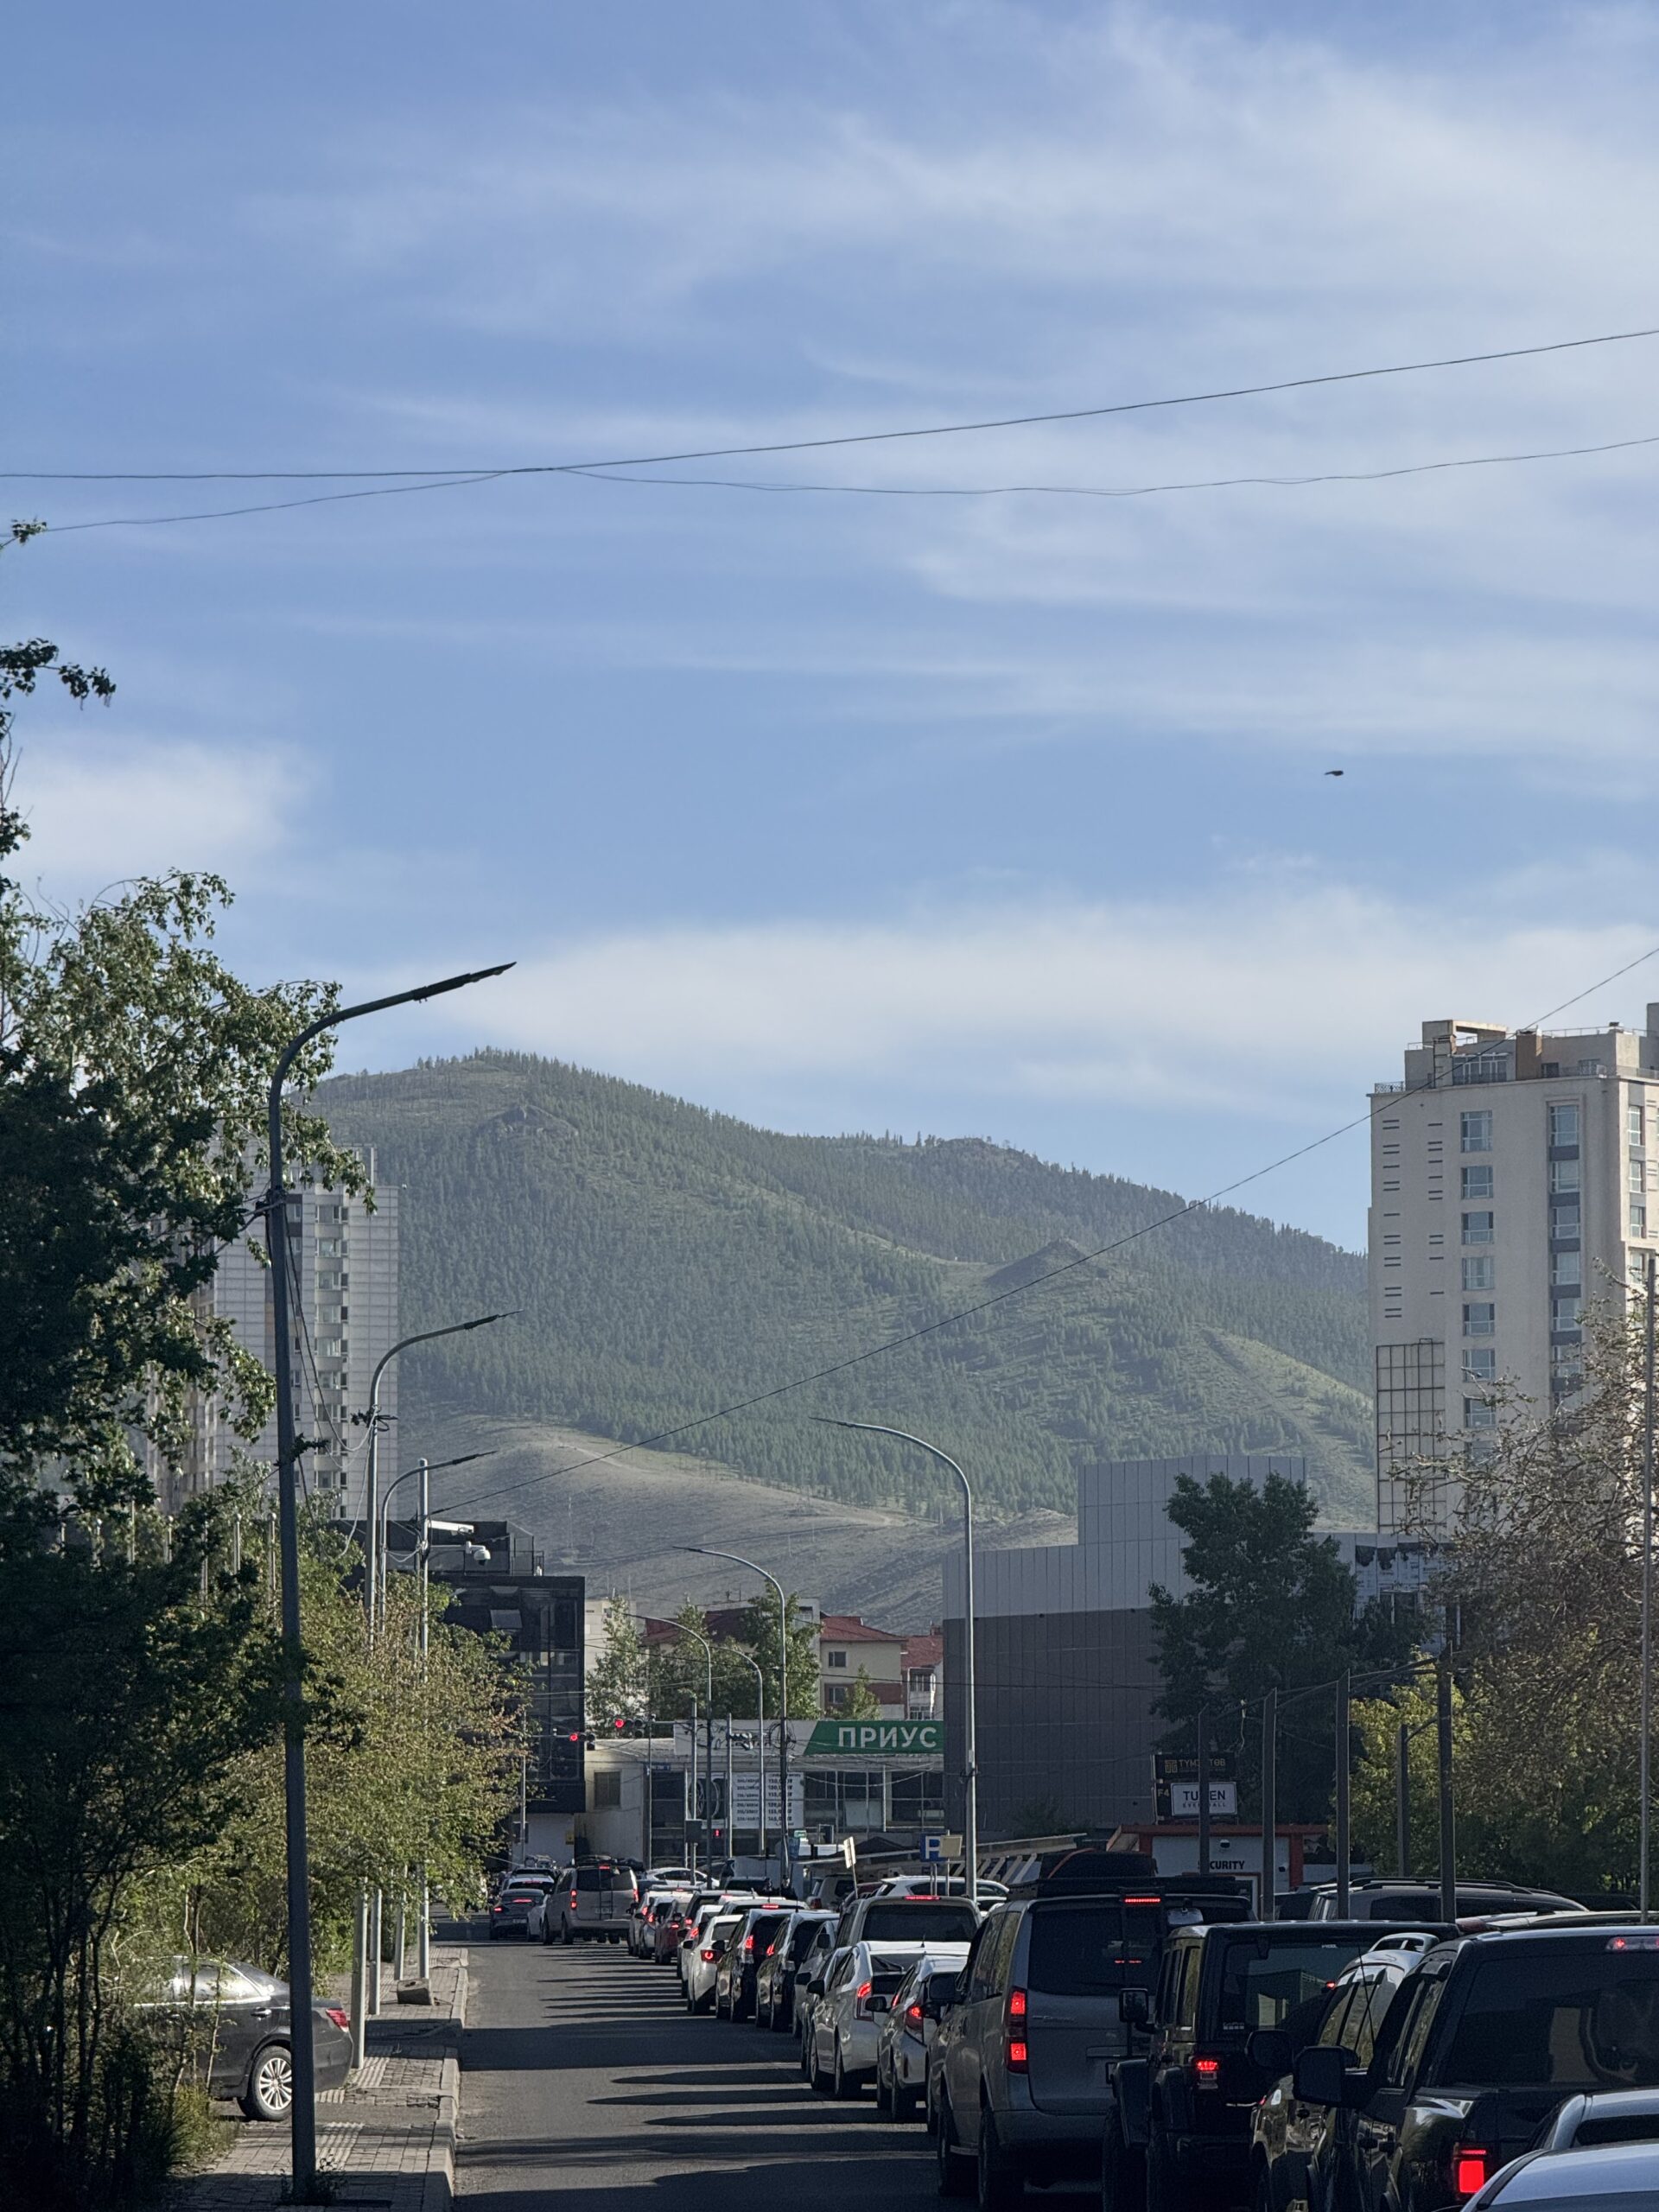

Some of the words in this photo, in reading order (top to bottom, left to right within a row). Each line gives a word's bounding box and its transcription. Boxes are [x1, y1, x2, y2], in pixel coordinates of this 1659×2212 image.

[838, 1727, 937, 1748] ПРИУС
[1183, 1790, 1225, 1801] TUEN
[1198, 1860, 1245, 1870] CURITY
